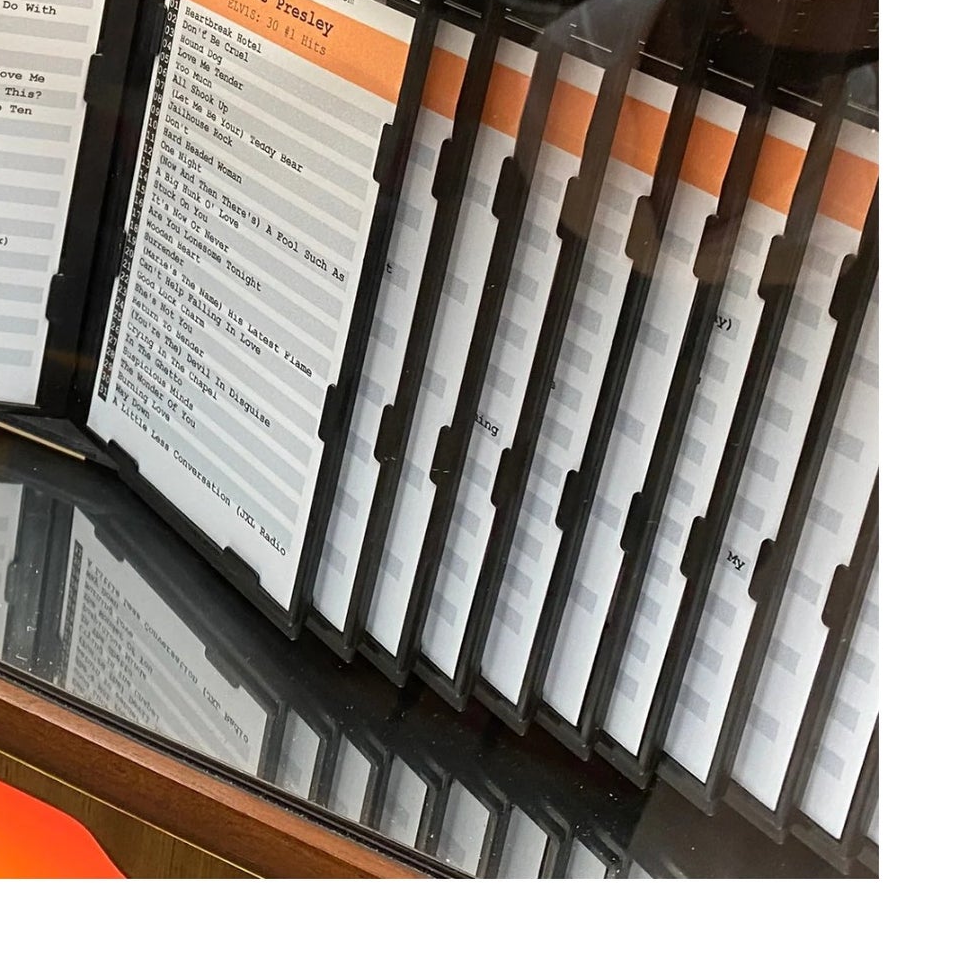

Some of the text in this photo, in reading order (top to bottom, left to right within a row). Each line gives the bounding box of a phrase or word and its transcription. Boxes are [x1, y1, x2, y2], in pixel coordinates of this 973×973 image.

[2, 0, 18, 11] Do
[25, 3, 57, 15] With
[184, 6, 262, 54] Heartbreak Hotel
[266, 16, 279, 31] 30
[284, 26, 295, 40] #1
[301, 34, 326, 56] Hits
[177, 46, 244, 91] Love Me Tender
[4, 87, 42, 99] This?
[172, 73, 229, 115] All Shook Up
[167, 101, 233, 147] Jailhouse Rock
[160, 140, 202, 173] One Night
[162, 127, 242, 185] Hard Headed Woman
[153, 180, 208, 224] Stuck On You
[155, 167, 239, 229] A Big Hunk O' Love
[159, 155, 345, 282] (Now And Then There's) A Fool Such As
[120, 358, 196, 429] The Wonder Of You
[122, 346, 194, 411] Suspicious Minds
[726, 550, 746, 571] My
